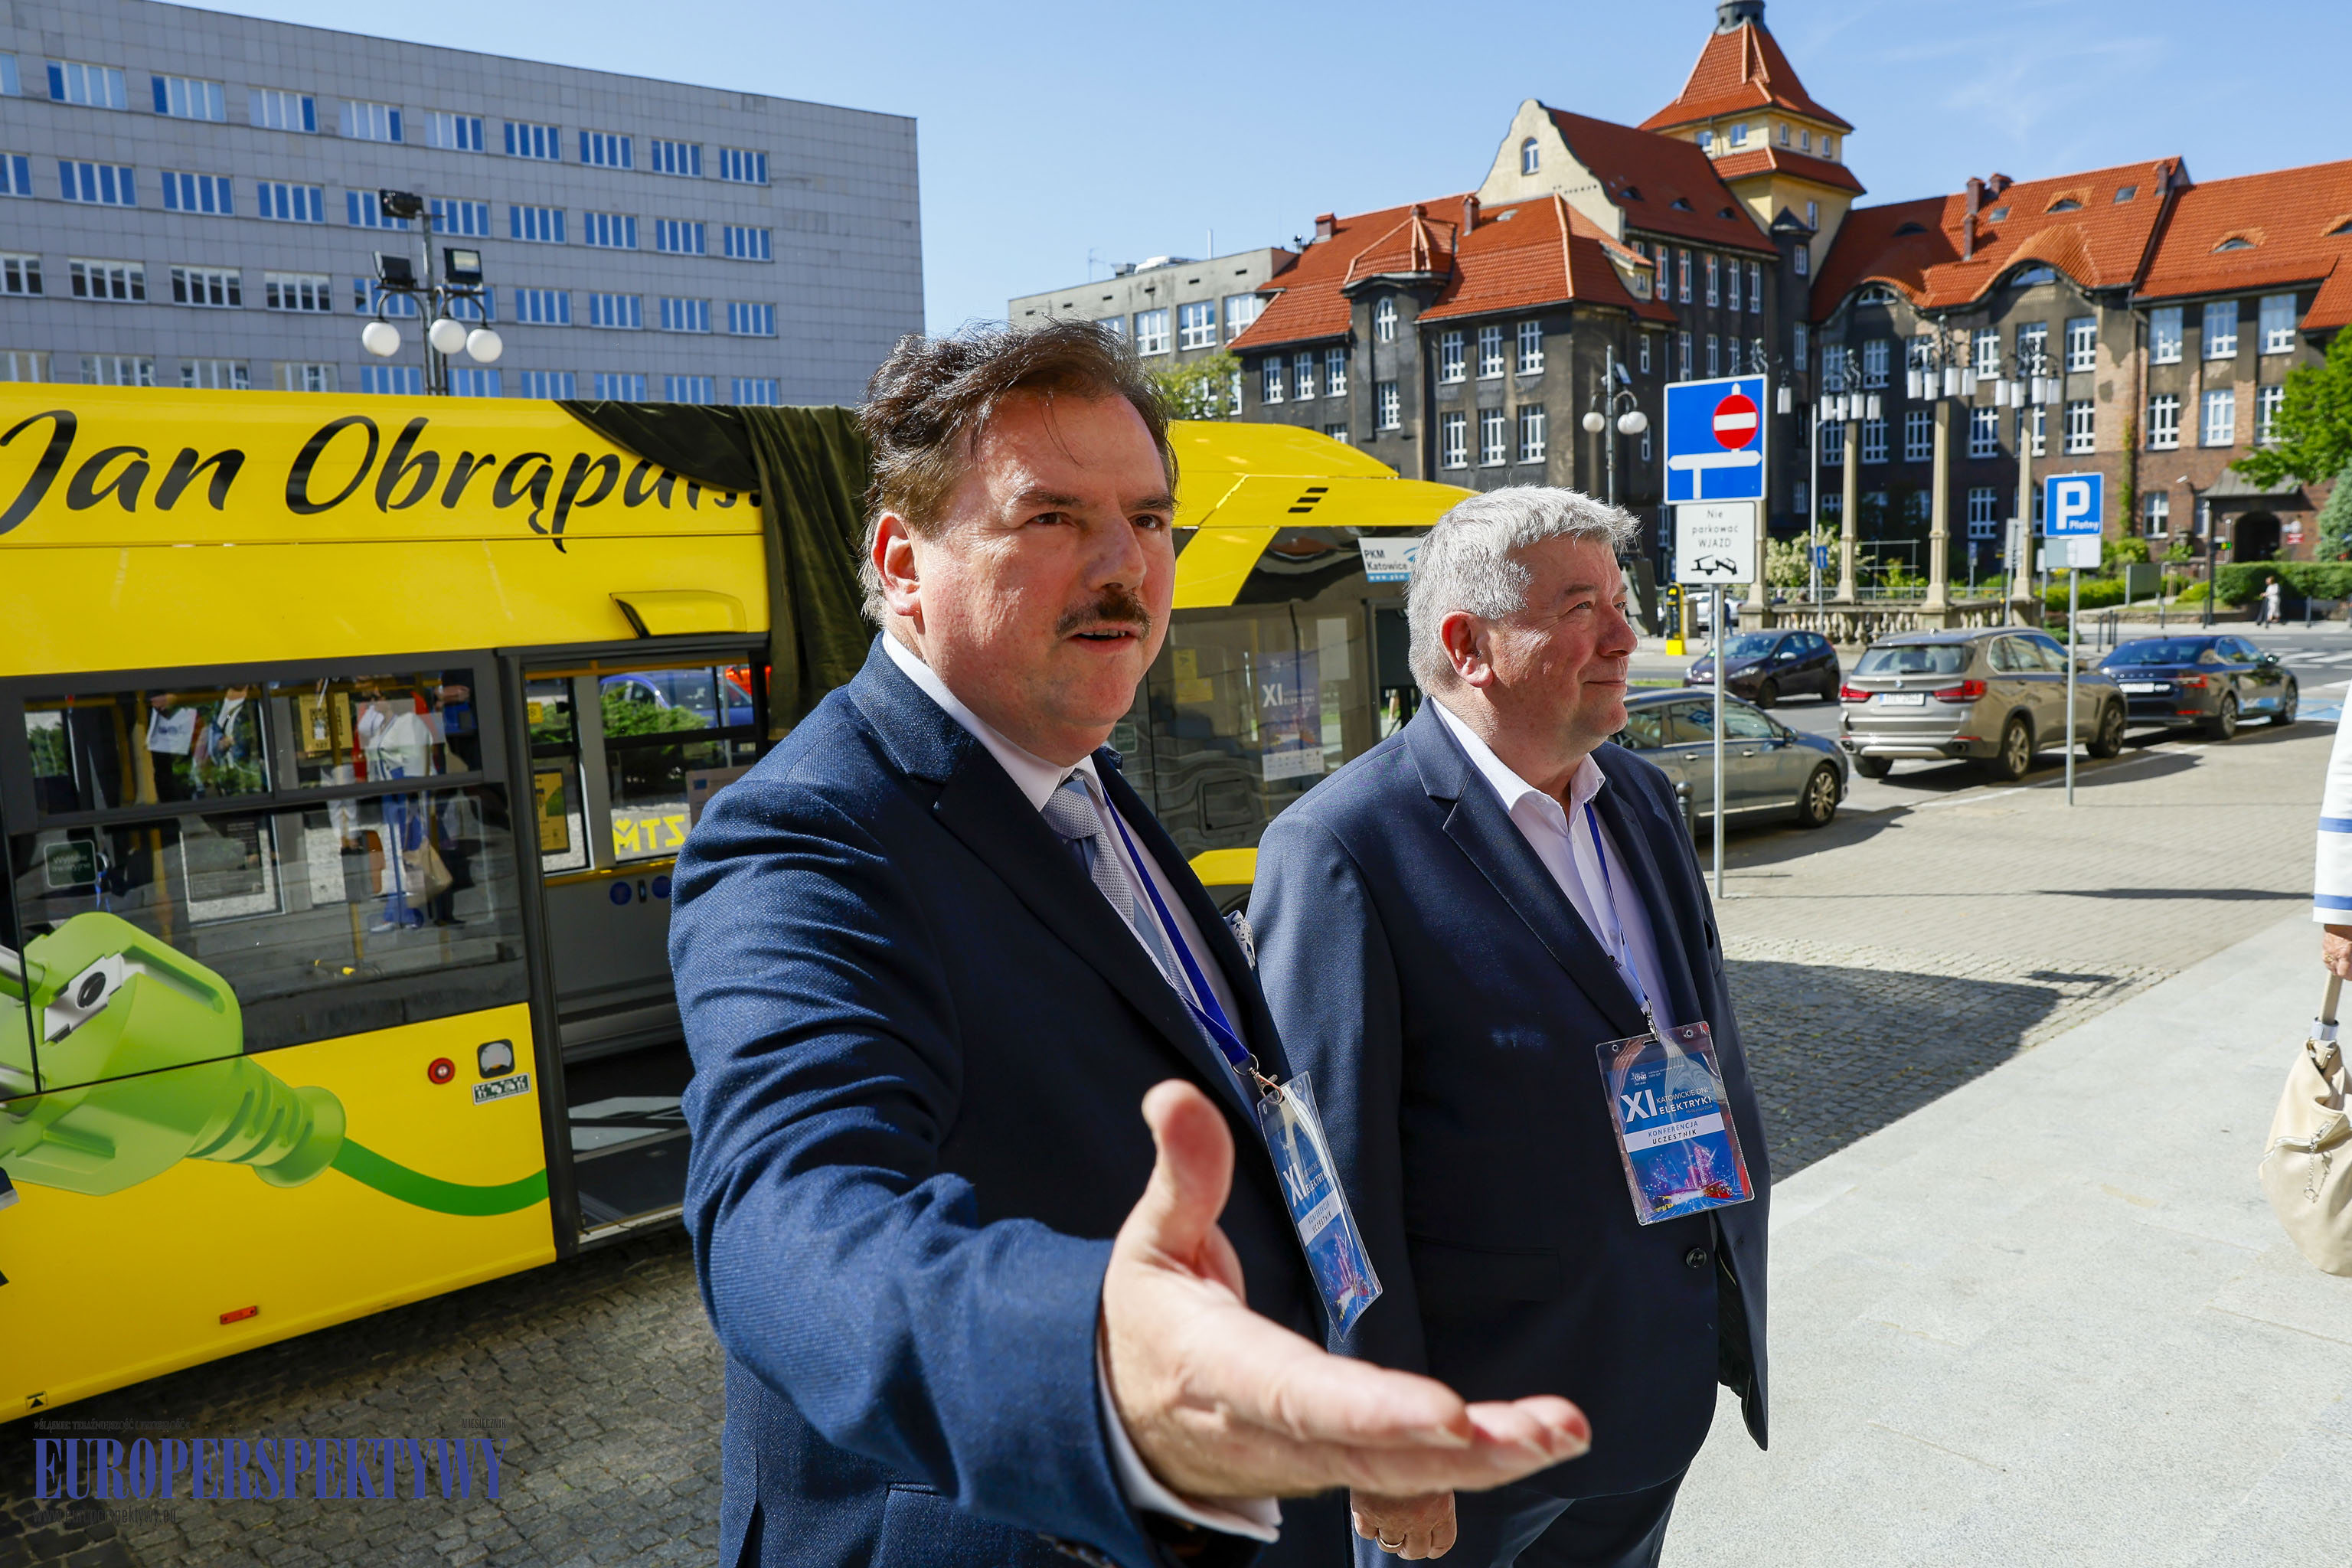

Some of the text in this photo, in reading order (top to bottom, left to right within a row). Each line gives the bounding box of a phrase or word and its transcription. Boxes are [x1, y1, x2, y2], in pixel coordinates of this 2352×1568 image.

[0, 410, 762, 553] Jan Obrąpa
[1707, 510, 1723, 518] Nie
[2056, 480, 2090, 530] P
[1364, 550, 1386, 558] PKM
[1366, 561, 1408, 570] Katowice
[1262, 683, 1284, 707] XI
[1656, 1086, 1709, 1104] KATOWICKIE DNI
[1620, 1089, 1658, 1122] XI
[1658, 1096, 1713, 1115] ELEKTRYKI
[1648, 1121, 1698, 1137] KONFERENCJA
[1652, 1129, 1697, 1144] UCZESTNIK
[1282, 1161, 1308, 1207] XI
